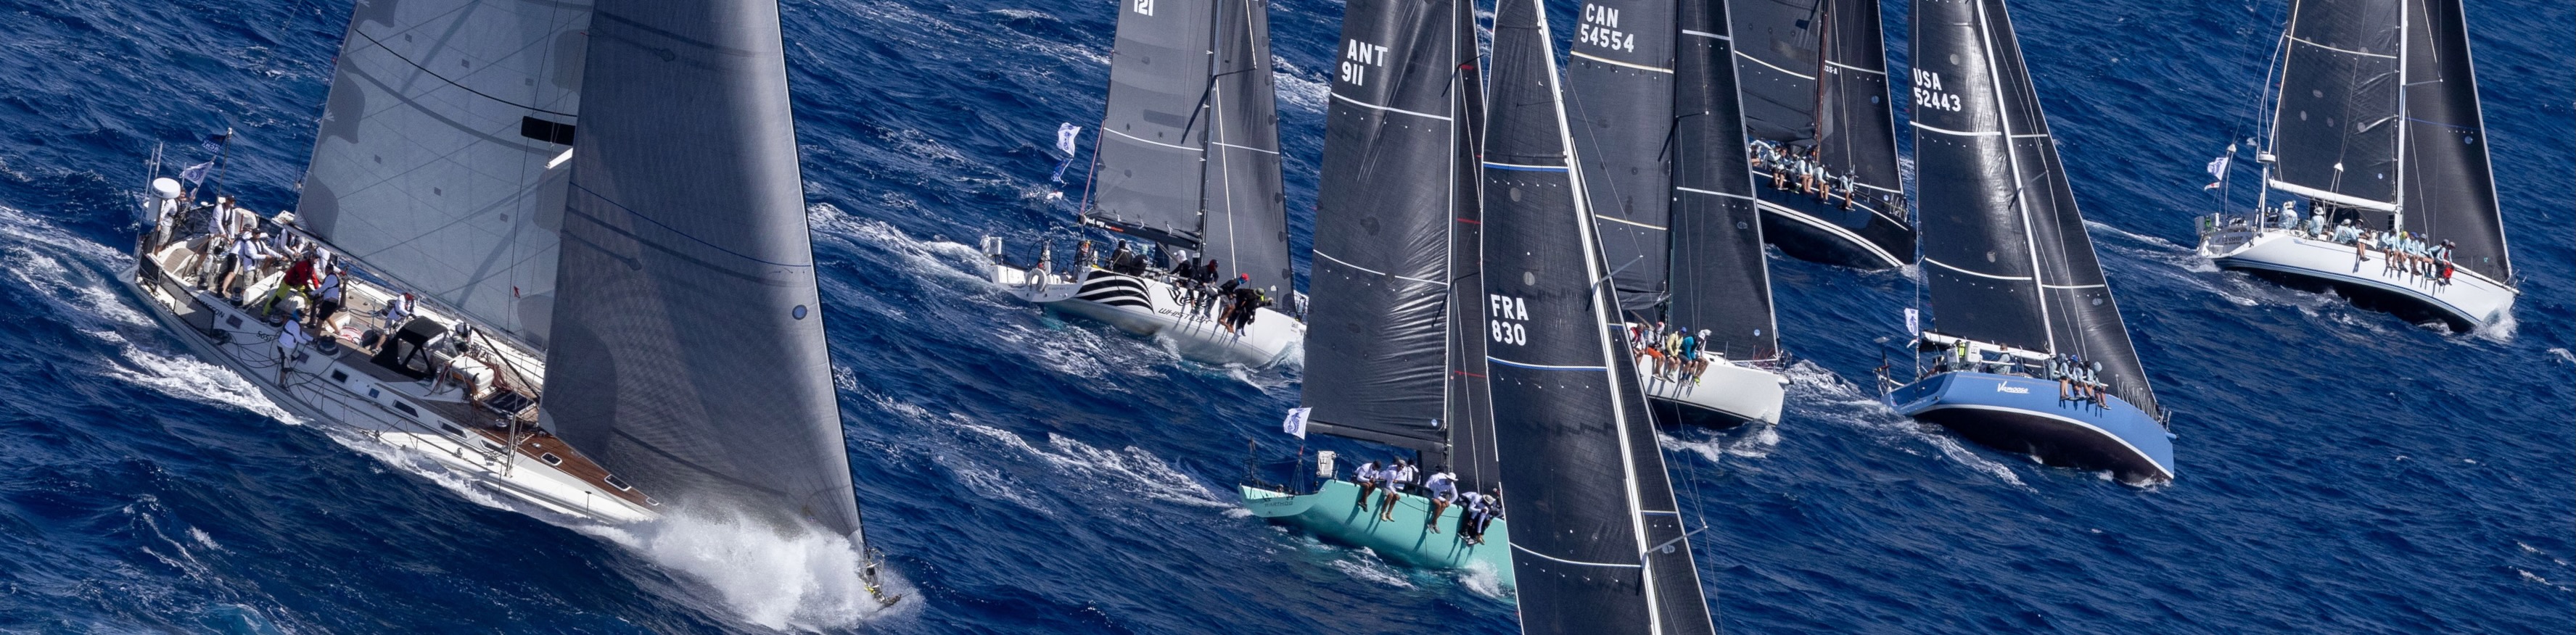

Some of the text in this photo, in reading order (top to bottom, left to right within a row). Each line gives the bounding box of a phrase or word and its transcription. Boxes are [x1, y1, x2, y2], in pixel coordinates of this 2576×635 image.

[1134, 0, 1153, 16] 121
[1586, 3, 1619, 28] CAN
[1581, 23, 1634, 53] 54554
[1347, 38, 1388, 67] ANT
[1341, 61, 1364, 86] 911
[1913, 67, 1943, 91] USA
[1913, 86, 1962, 112] 52443
[1490, 294, 1529, 321] FRA
[1491, 320, 1526, 346] 830
[1997, 380, 2030, 394] Vamoose
